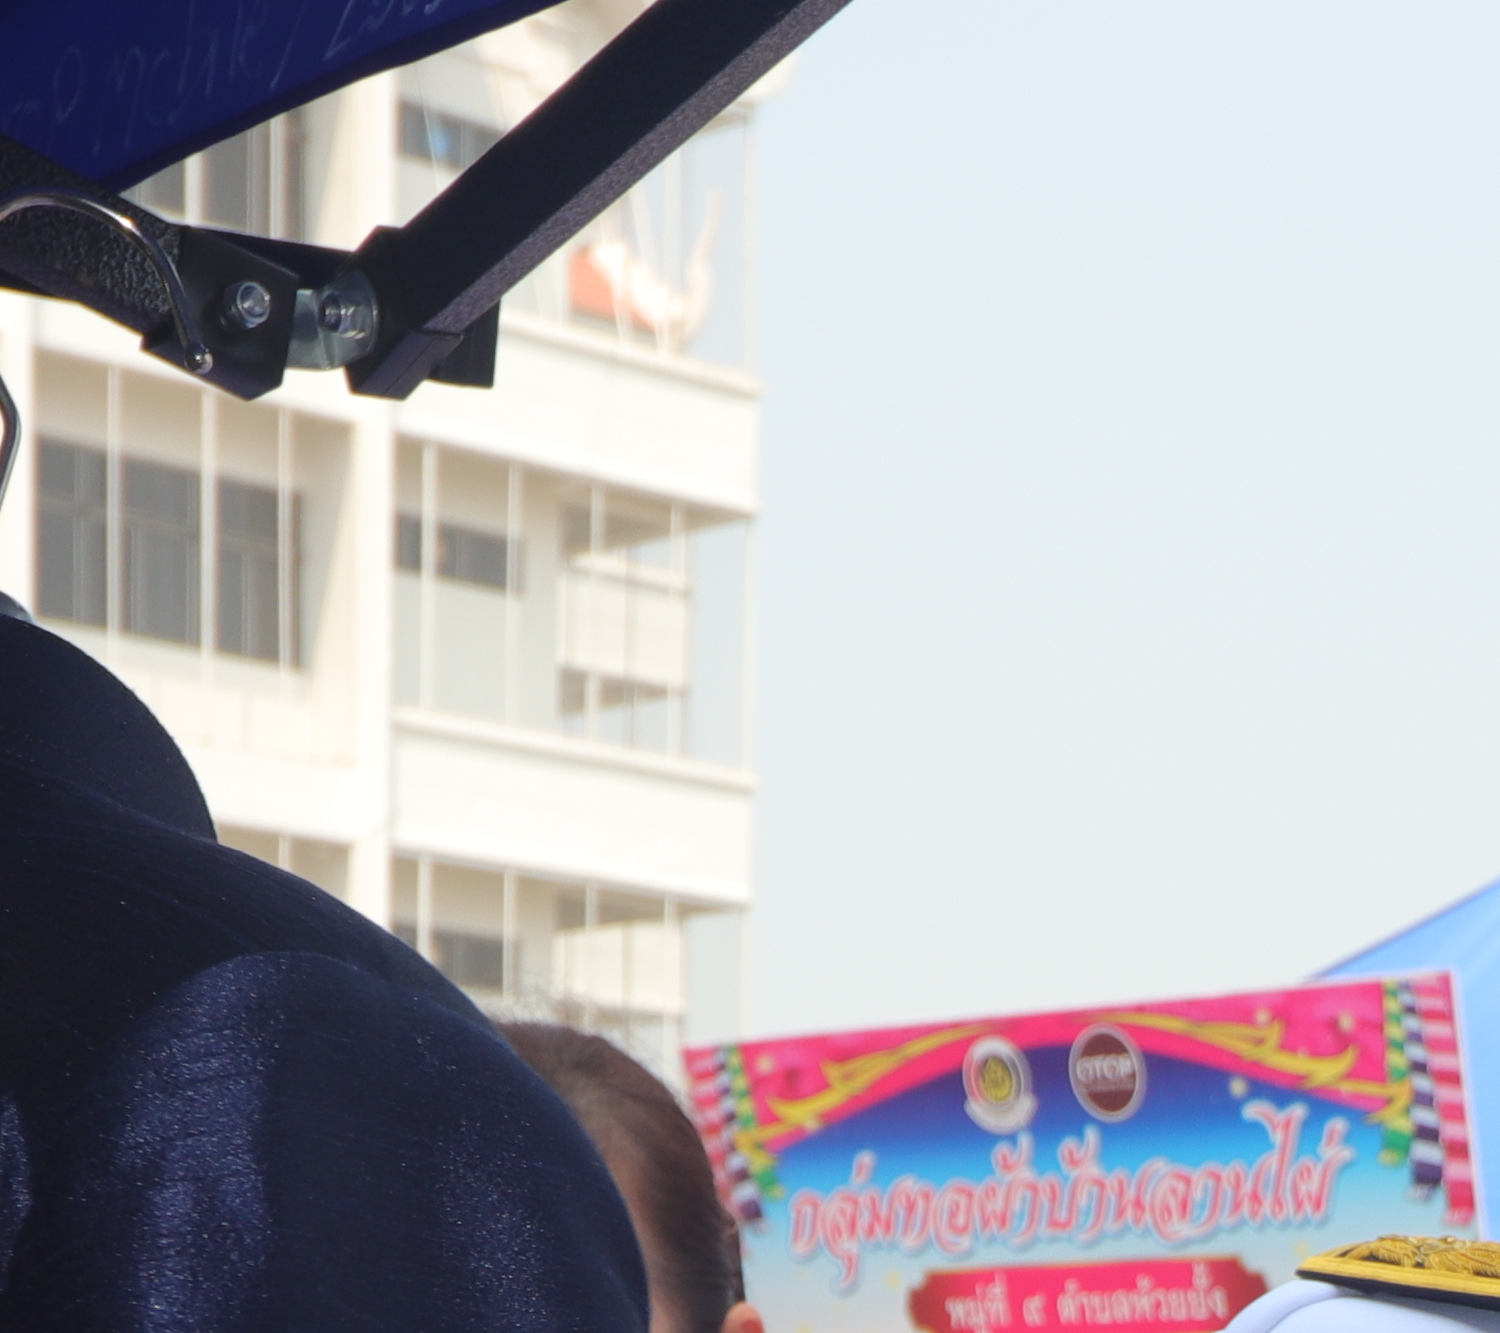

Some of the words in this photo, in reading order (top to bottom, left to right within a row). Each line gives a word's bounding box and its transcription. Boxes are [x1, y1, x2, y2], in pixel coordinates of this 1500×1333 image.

[1076, 1054, 1133, 1083] OTOP
[790, 1101, 1355, 1288] กลุ่มทอผ้าบ้านลานไผ่
